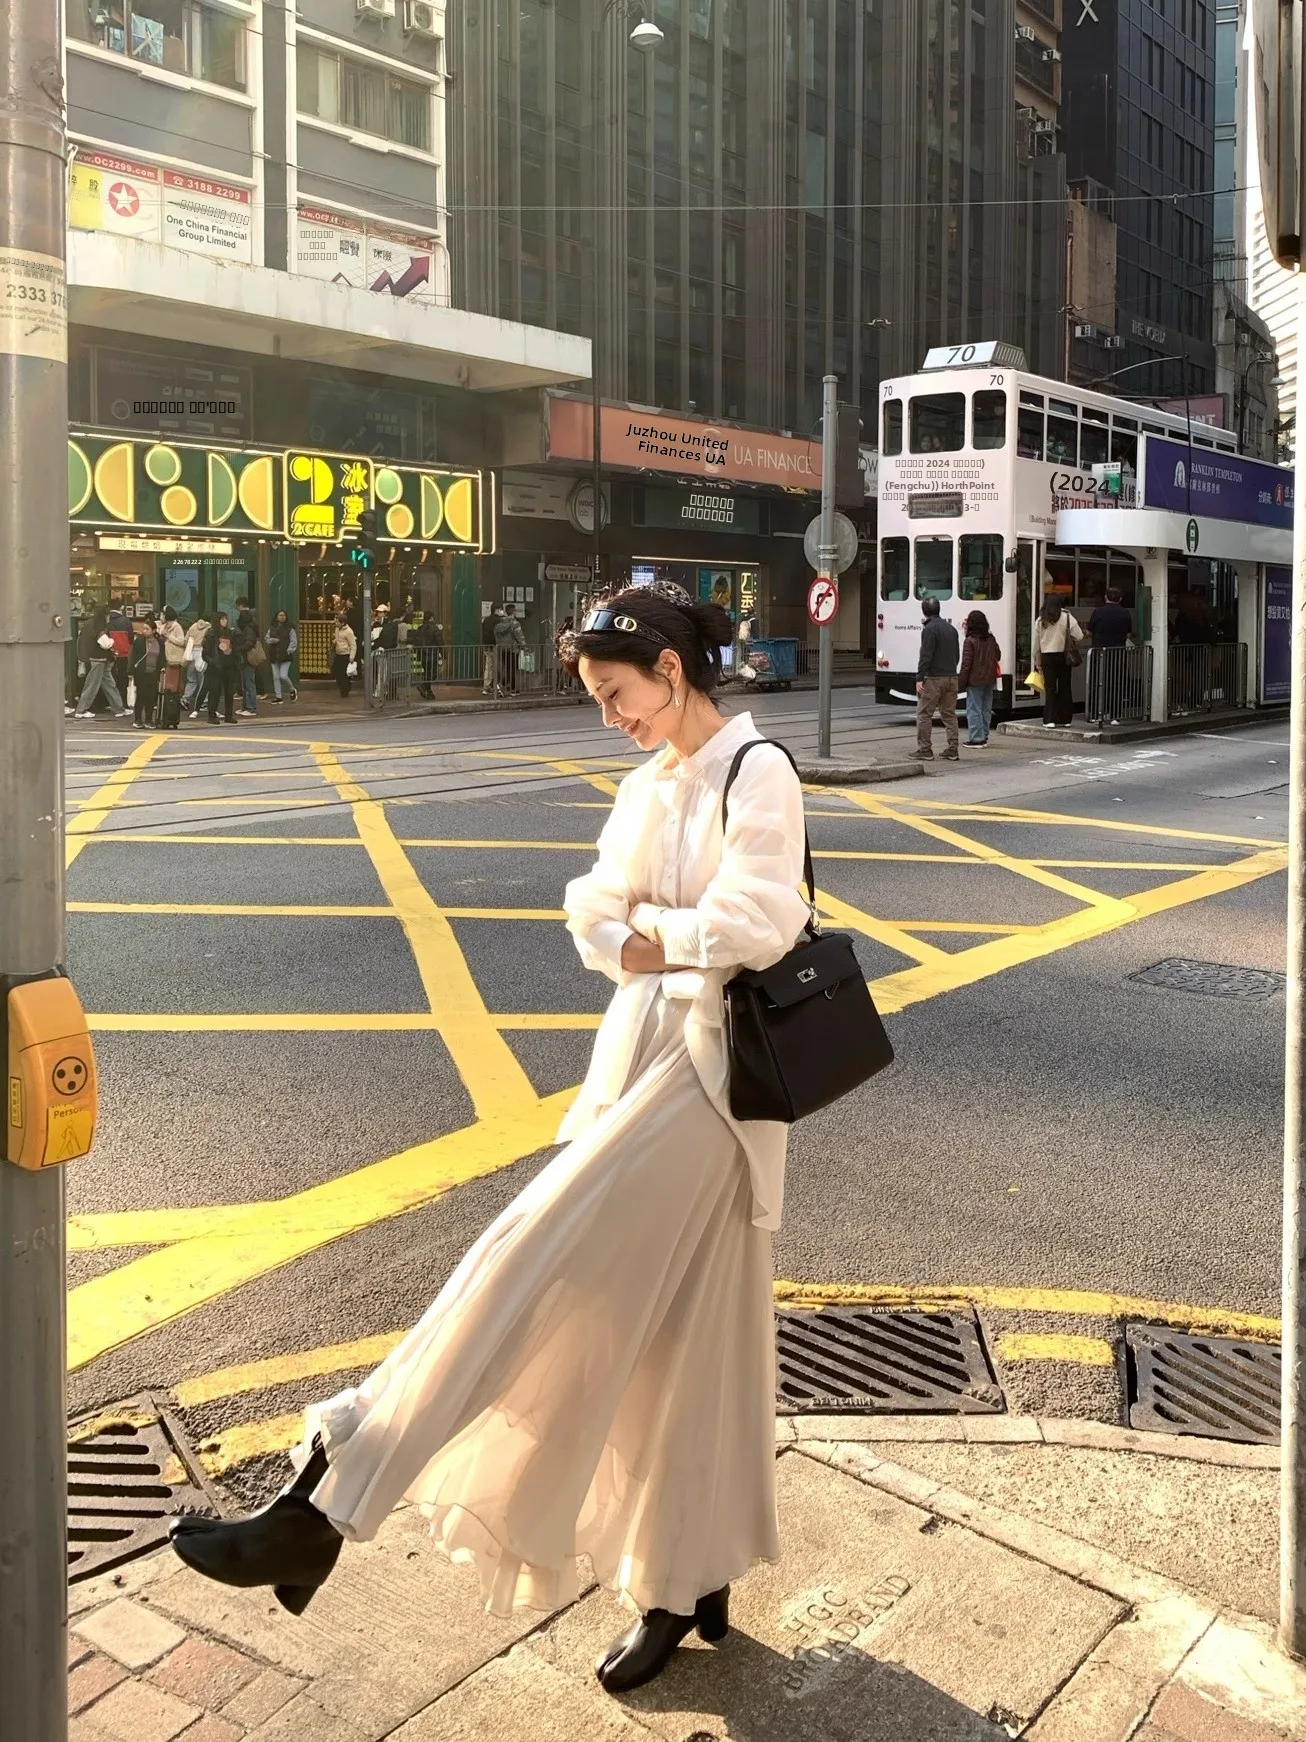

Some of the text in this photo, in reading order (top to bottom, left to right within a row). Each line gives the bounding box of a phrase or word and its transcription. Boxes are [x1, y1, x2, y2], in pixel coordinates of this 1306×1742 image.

[187, 178, 241, 200] 3188 2299
[166, 214, 247, 241] One China Financial
[178, 229, 236, 249] Group Limited
[6, 283, 46, 303] 2333
[946, 345, 976, 364] 70
[989, 374, 1004, 386] 70
[884, 385, 893, 397] 70
[734, 445, 812, 475] UA FINANCE
[1191, 462, 1215, 477] RANKLIN
